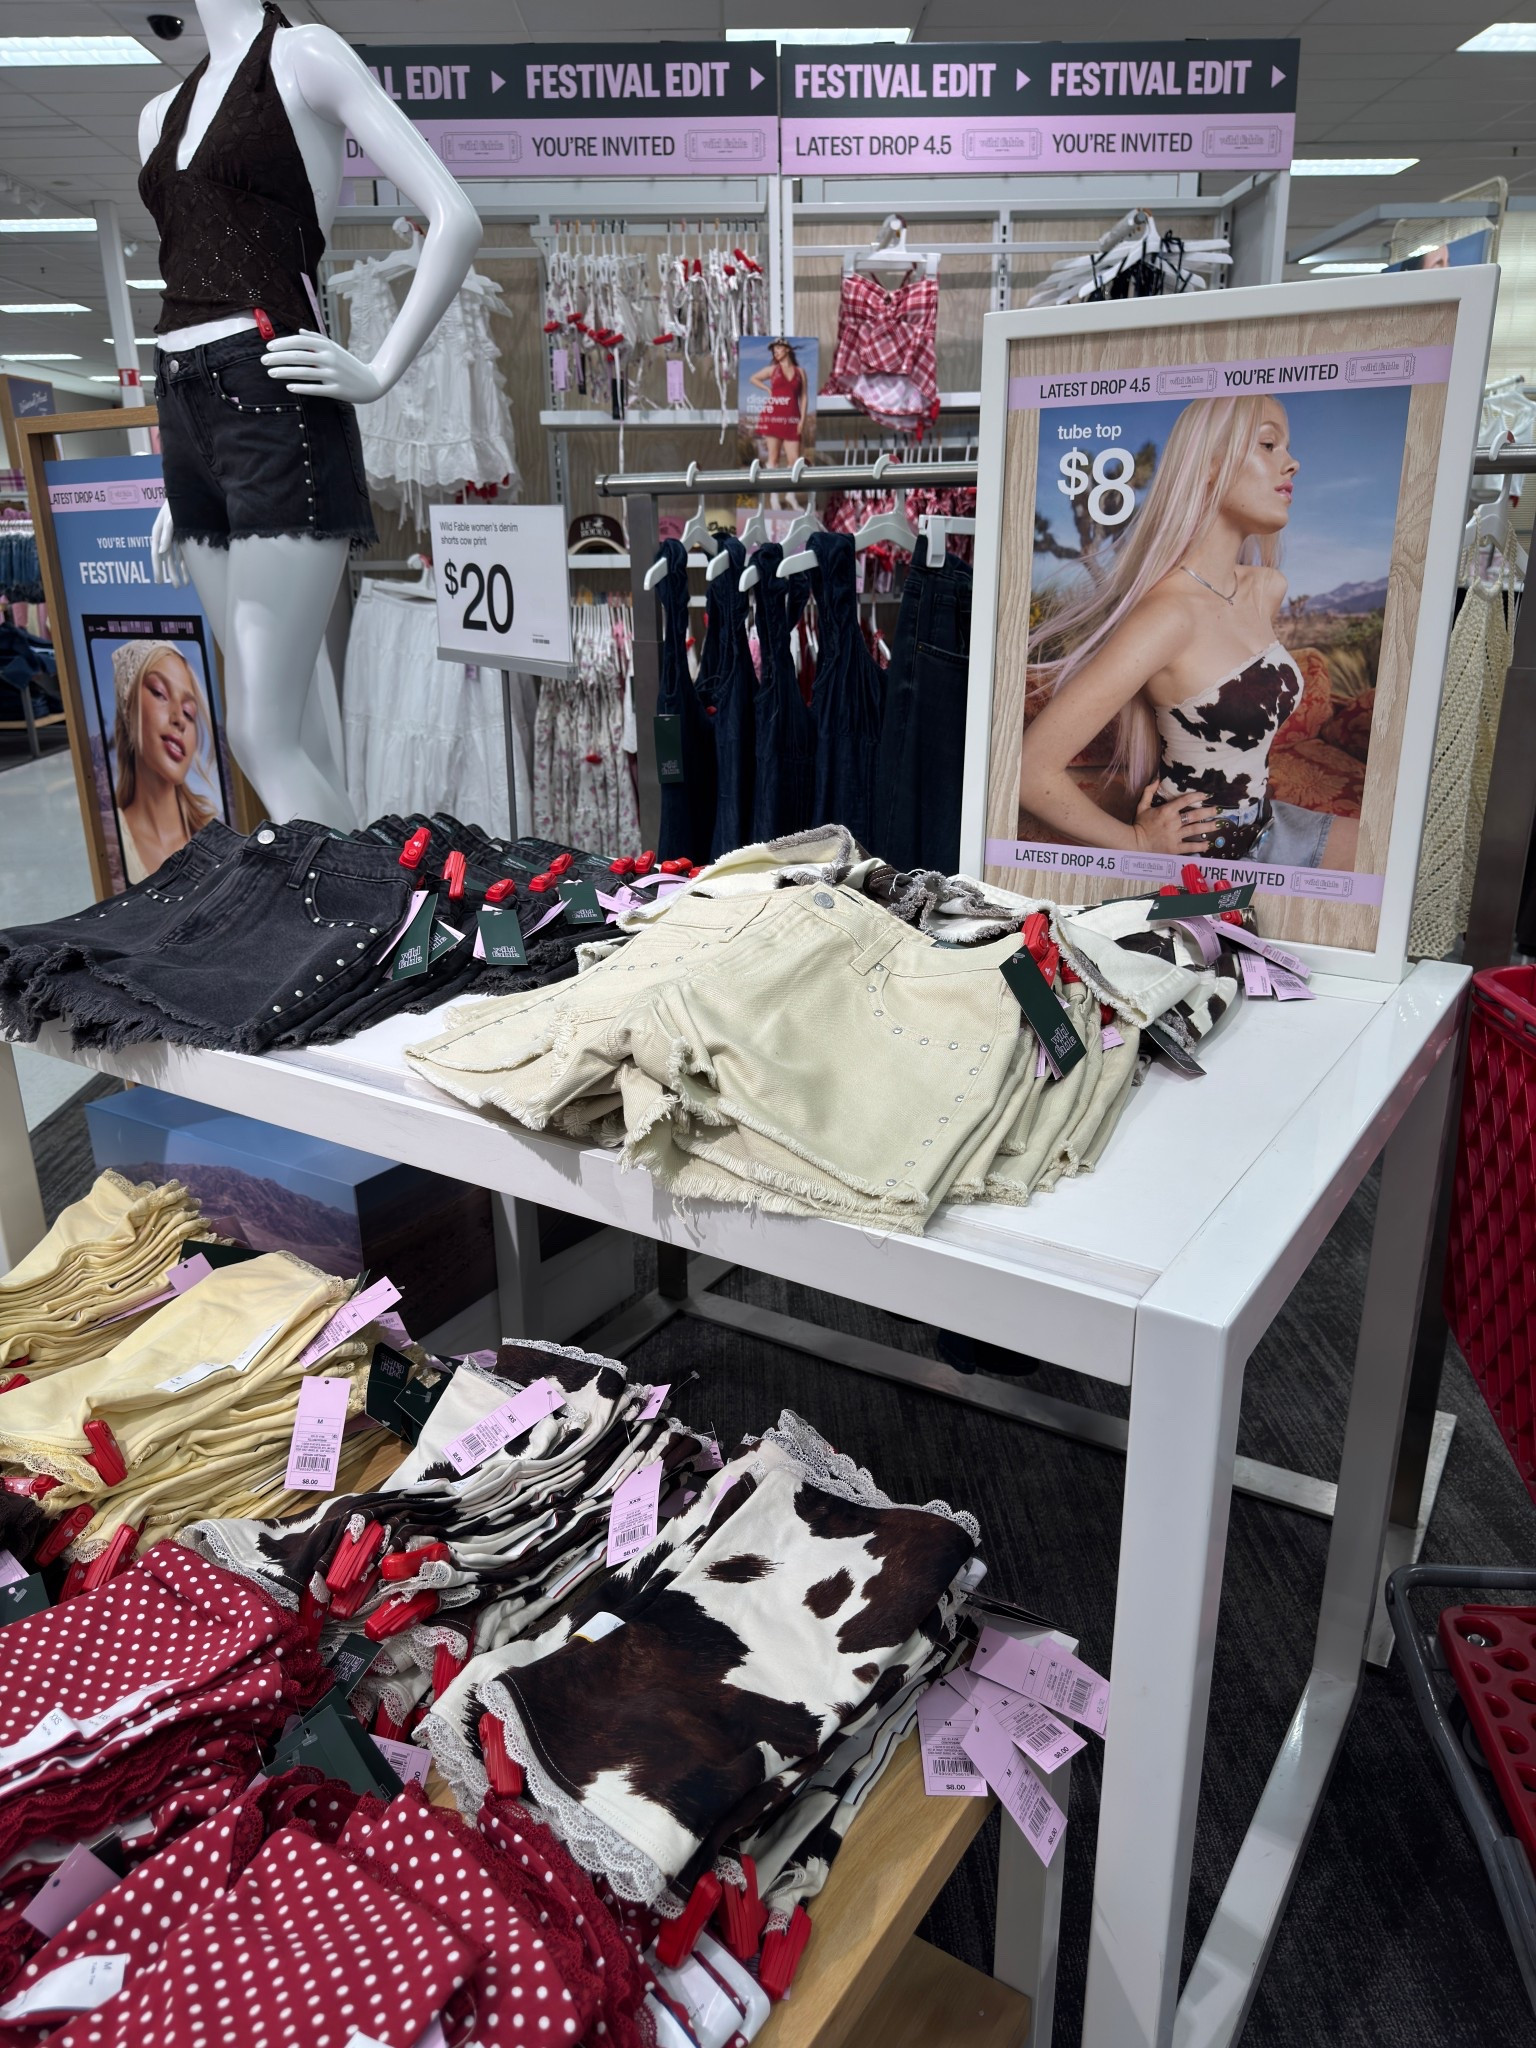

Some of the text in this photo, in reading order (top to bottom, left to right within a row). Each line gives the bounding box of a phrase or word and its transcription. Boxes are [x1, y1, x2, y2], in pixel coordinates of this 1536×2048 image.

[406, 66, 470, 100] EDIT
[526, 62, 730, 99] FESTIVAL EDIT
[794, 63, 997, 98] FESTIVAL EDIT
[1050, 60, 1252, 96] FESTIVAL EDIT
[532, 136, 675, 156] YOU'RE INVITED
[796, 135, 952, 156] LATEST DROP 4.5
[1052, 132, 1192, 154] YOU'RE INVITED
[1224, 363, 1339, 387] YOU'RE INVITED
[1040, 378, 1150, 400] LATEST DROP 4.5
[1058, 424, 1122, 441] tube top
[1057, 446, 1135, 526] $8
[74, 491, 94, 504] DROP
[95, 490, 106, 502] 4.5
[440, 522, 518, 532] Wild Fable women's denim
[97, 536, 153, 549] YOU'RE INVIT
[441, 536, 458, 544] shorts
[474, 536, 488, 547] print
[79, 561, 150, 585] FESTIVAL
[444, 558, 514, 634] $20
[1015, 848, 1116, 870] LATEST DROP 4.5
[1182, 864, 1285, 888] U'RE INVITED
[401, 946, 421, 960] wild
[508, 1414, 516, 1424] XXS
[302, 1478, 318, 1486] $8.00
[623, 1547, 640, 1557] $8.00
[1054, 1746, 1070, 1758] $8.00
[1006, 1768, 1012, 1778] M
[1048, 1828, 1058, 1846] $8.00
[103, 1962, 112, 1970] M
